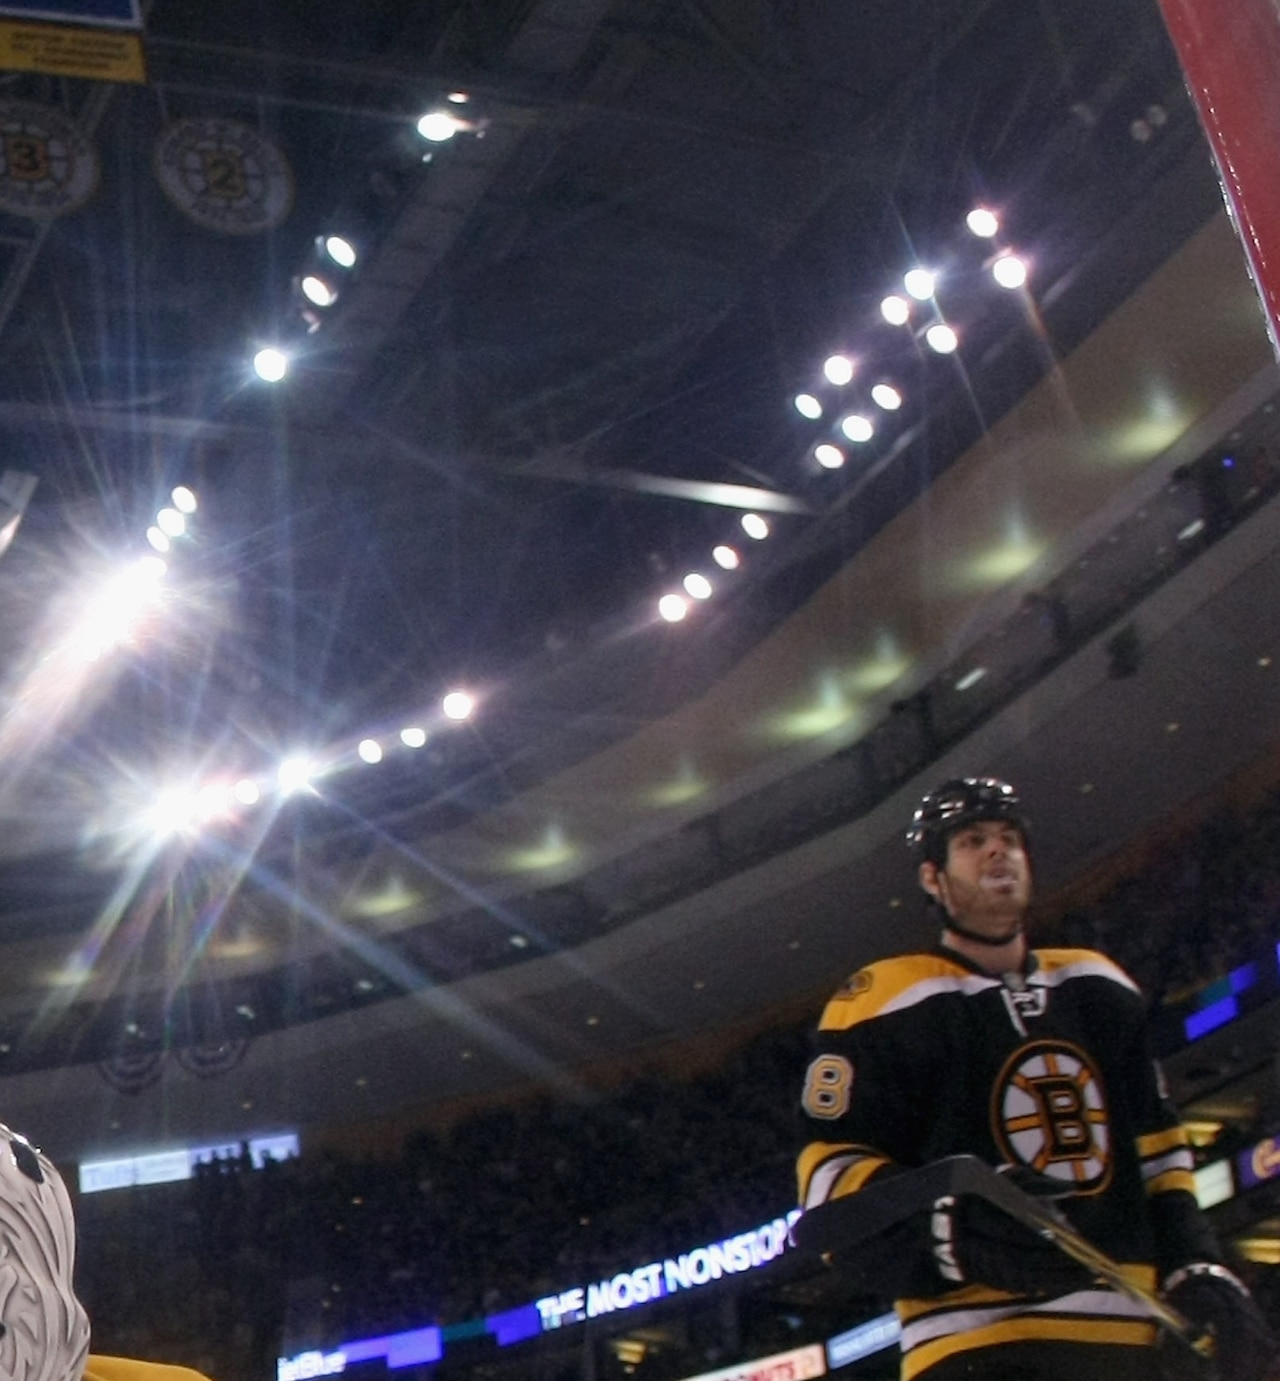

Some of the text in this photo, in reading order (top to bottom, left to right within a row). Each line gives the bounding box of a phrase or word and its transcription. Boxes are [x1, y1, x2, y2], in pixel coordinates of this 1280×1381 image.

[801, 1053, 854, 1121] 8
[535, 1217, 788, 1331] THE MOST NONSTOP
